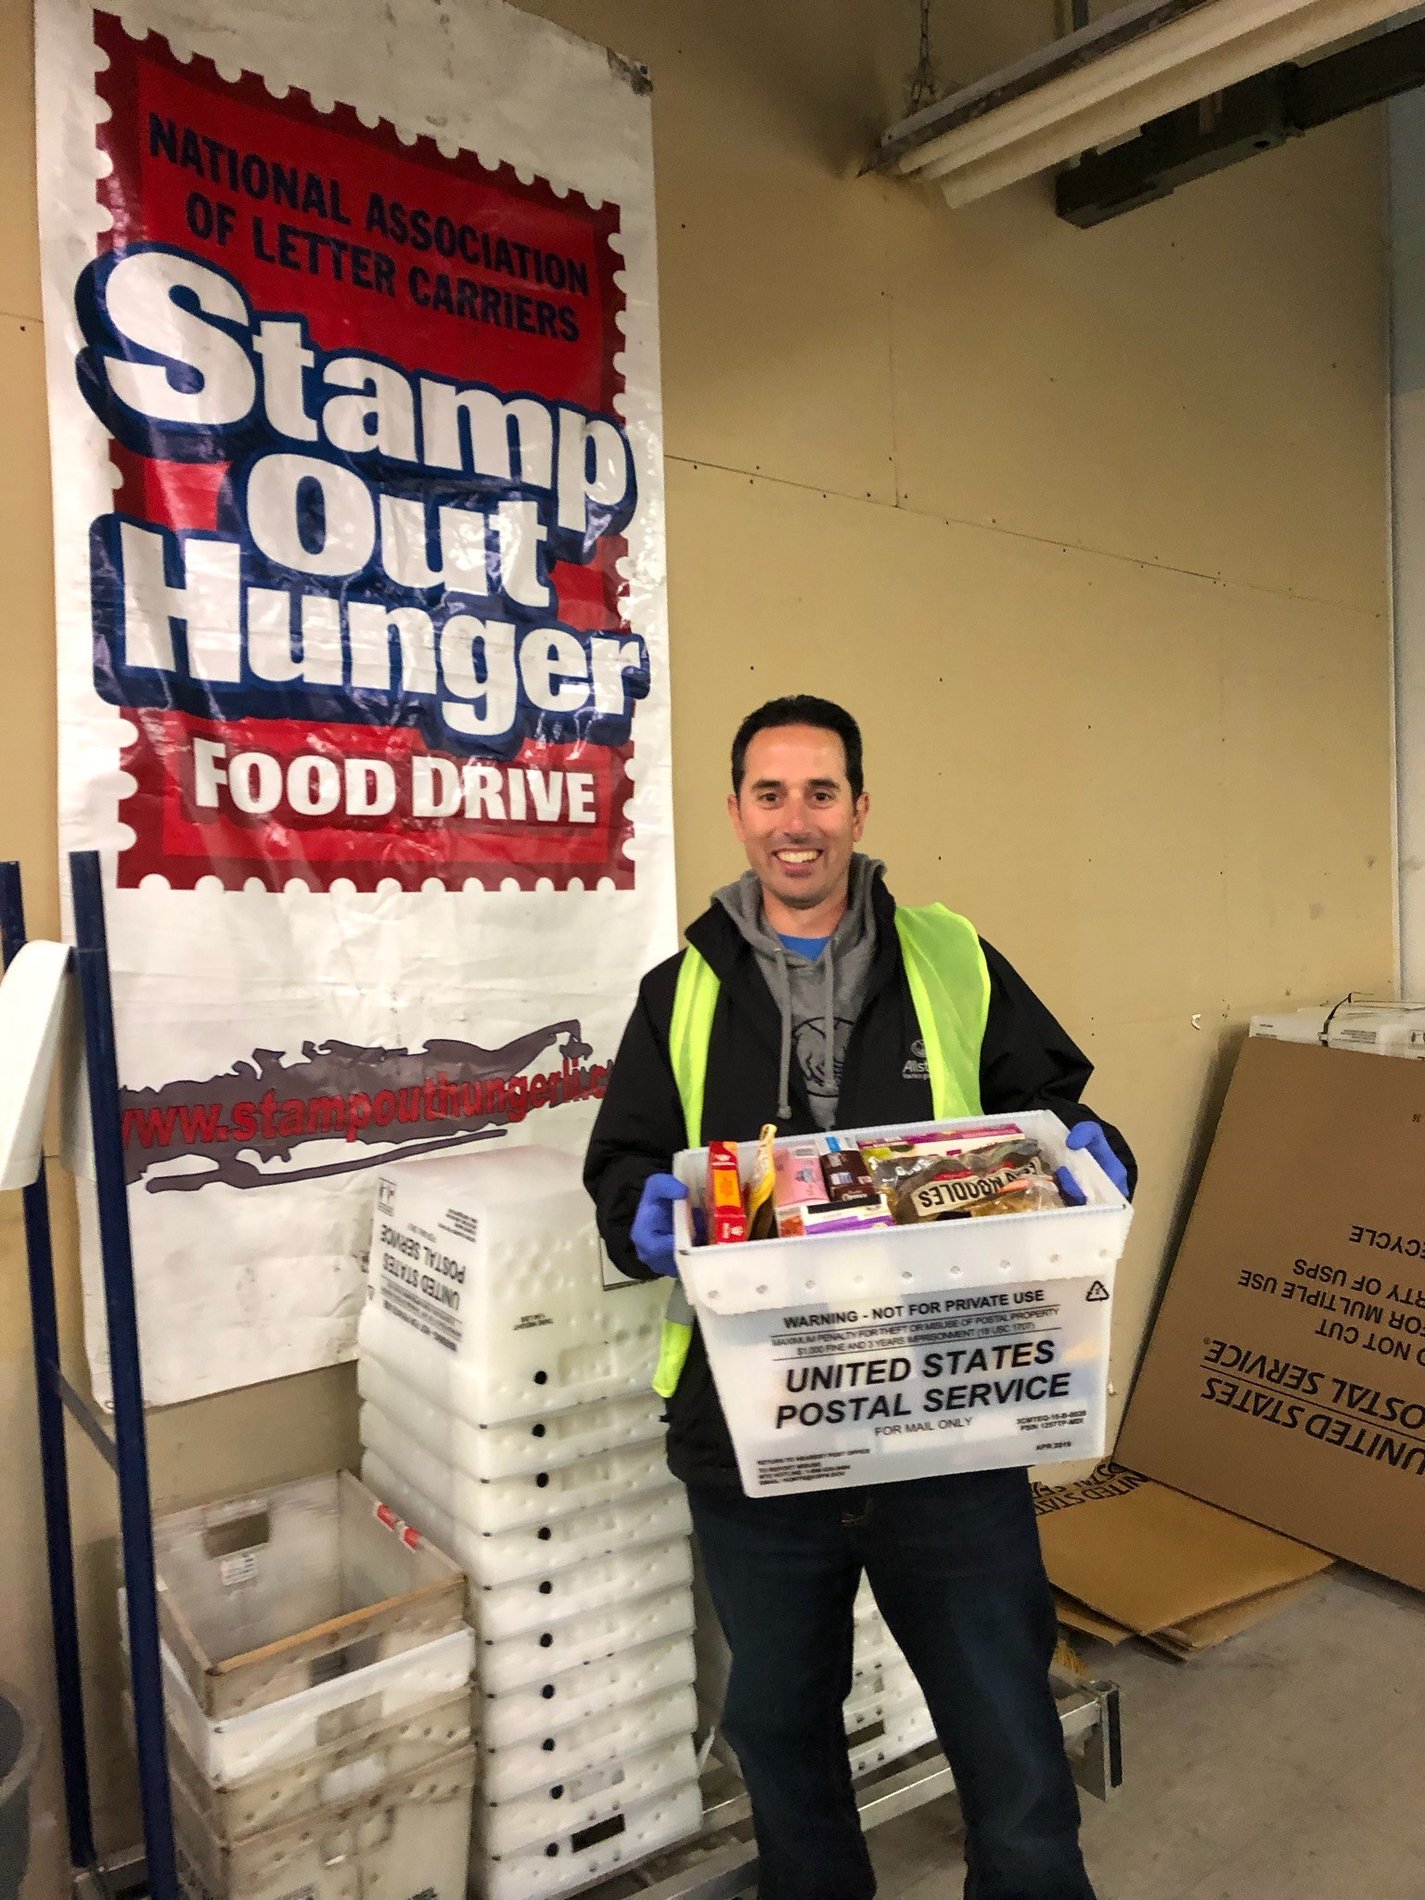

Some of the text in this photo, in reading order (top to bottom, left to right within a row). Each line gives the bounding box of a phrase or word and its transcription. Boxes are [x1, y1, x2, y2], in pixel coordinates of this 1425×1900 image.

[149, 112, 589, 298] NATIONAL ASSOCIATION
[186, 191, 581, 343] OF LETTER CARRIERS
[102, 251, 629, 534] Stamp
[246, 452, 551, 608] Out
[119, 520, 643, 737] Hunger
[192, 737, 598, 825] FOOD DRIVE
[918, 1174, 1005, 1208] NOODLES
[423, 1245, 467, 1285] POSTAL
[1238, 1269, 1278, 1294] USE
[1293, 1258, 1347, 1287] USPS
[421, 1274, 461, 1311] UNITED
[1281, 1280, 1384, 1325] MULTIPLE
[1351, 1275, 1382, 1296] OF
[784, 1311, 859, 1329] WARNING
[872, 1305, 903, 1320] NOT
[909, 1302, 941, 1316] FOR
[945, 1294, 1010, 1312] PRIVATE
[1013, 1289, 1045, 1304] USE
[817, 1331, 857, 1342] PENALTY
[859, 1328, 879, 1338] FOR
[925, 1319, 959, 1331] MISUSE
[961, 1317, 974, 1327] OF
[976, 1313, 1010, 1325] POSTAL
[1010, 1307, 1060, 1320] PROPERTY
[848, 1340, 866, 1350] AND
[874, 1336, 906, 1347] YEARS
[1314, 1318, 1360, 1345] CUT
[1362, 1332, 1412, 1362] NOT
[786, 1339, 1056, 1393] UNITED STATES
[775, 1372, 1071, 1430] POSTAL SERVICE
[874, 1416, 973, 1437] FOR MAIL ONLY
[1201, 1376, 1425, 1476] UNITED STATES
